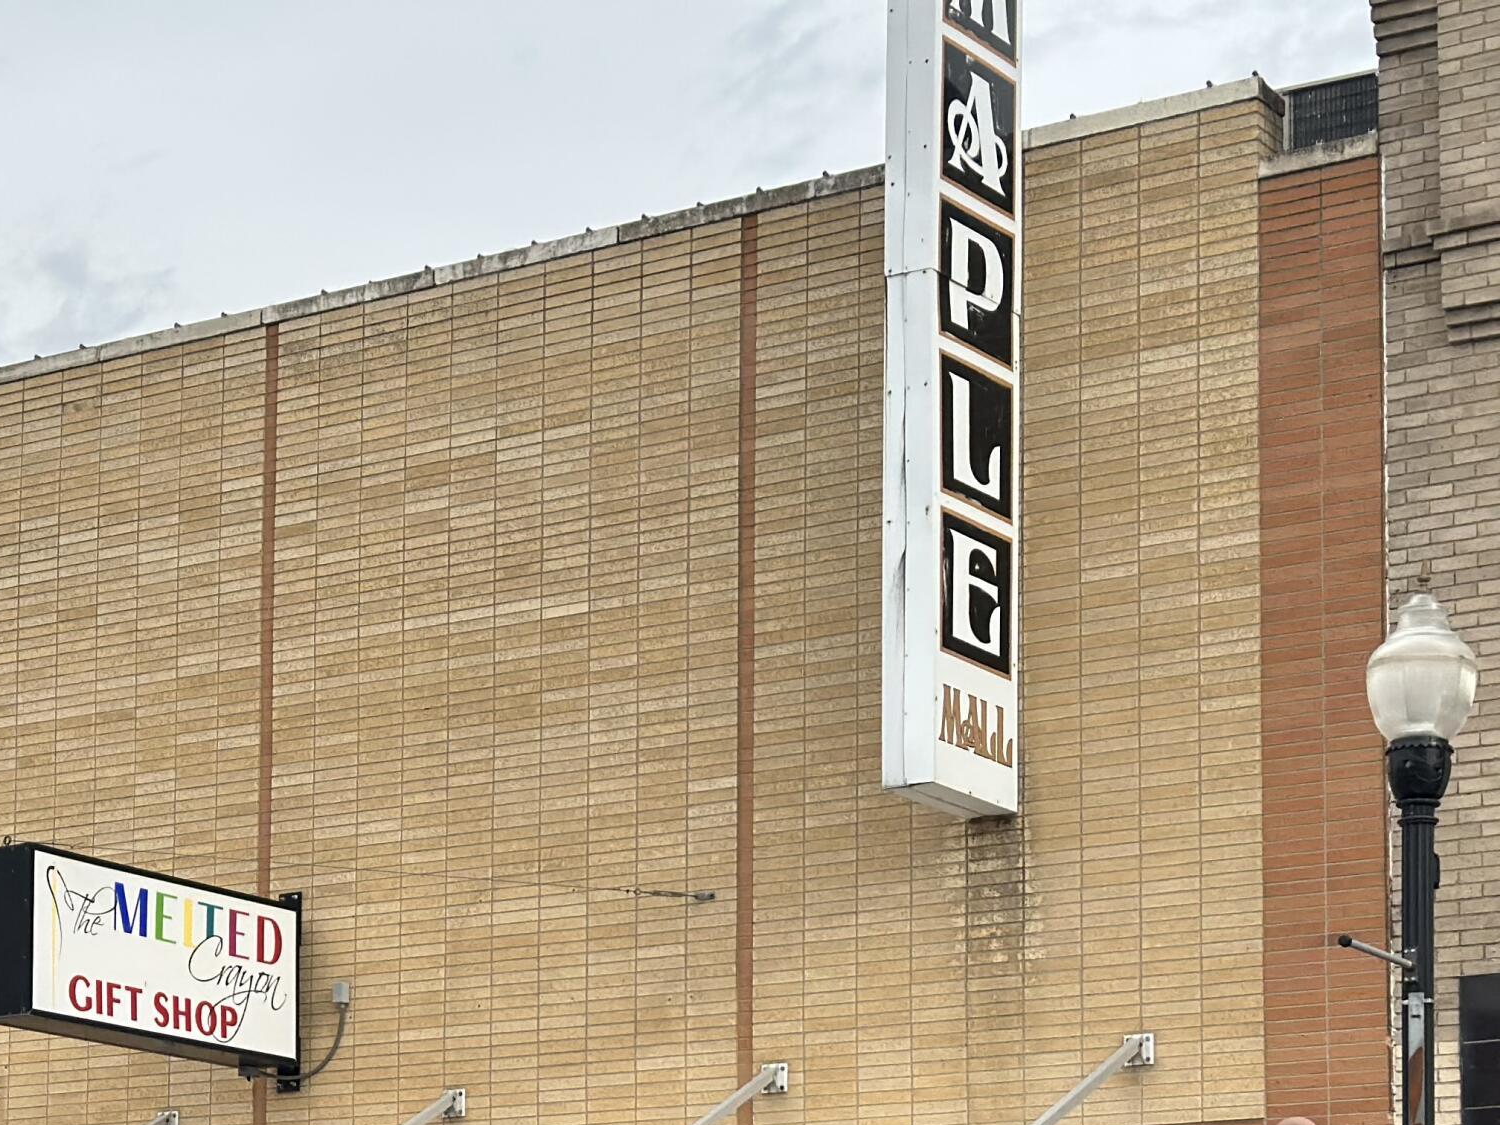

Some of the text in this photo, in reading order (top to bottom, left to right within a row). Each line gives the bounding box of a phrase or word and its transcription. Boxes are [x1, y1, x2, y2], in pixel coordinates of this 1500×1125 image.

[938, 683, 1013, 768] MALL
[64, 881, 283, 965] The MELTED
[68, 974, 239, 1039] GIFT SHOP
[188, 935, 287, 1042] Crayon
